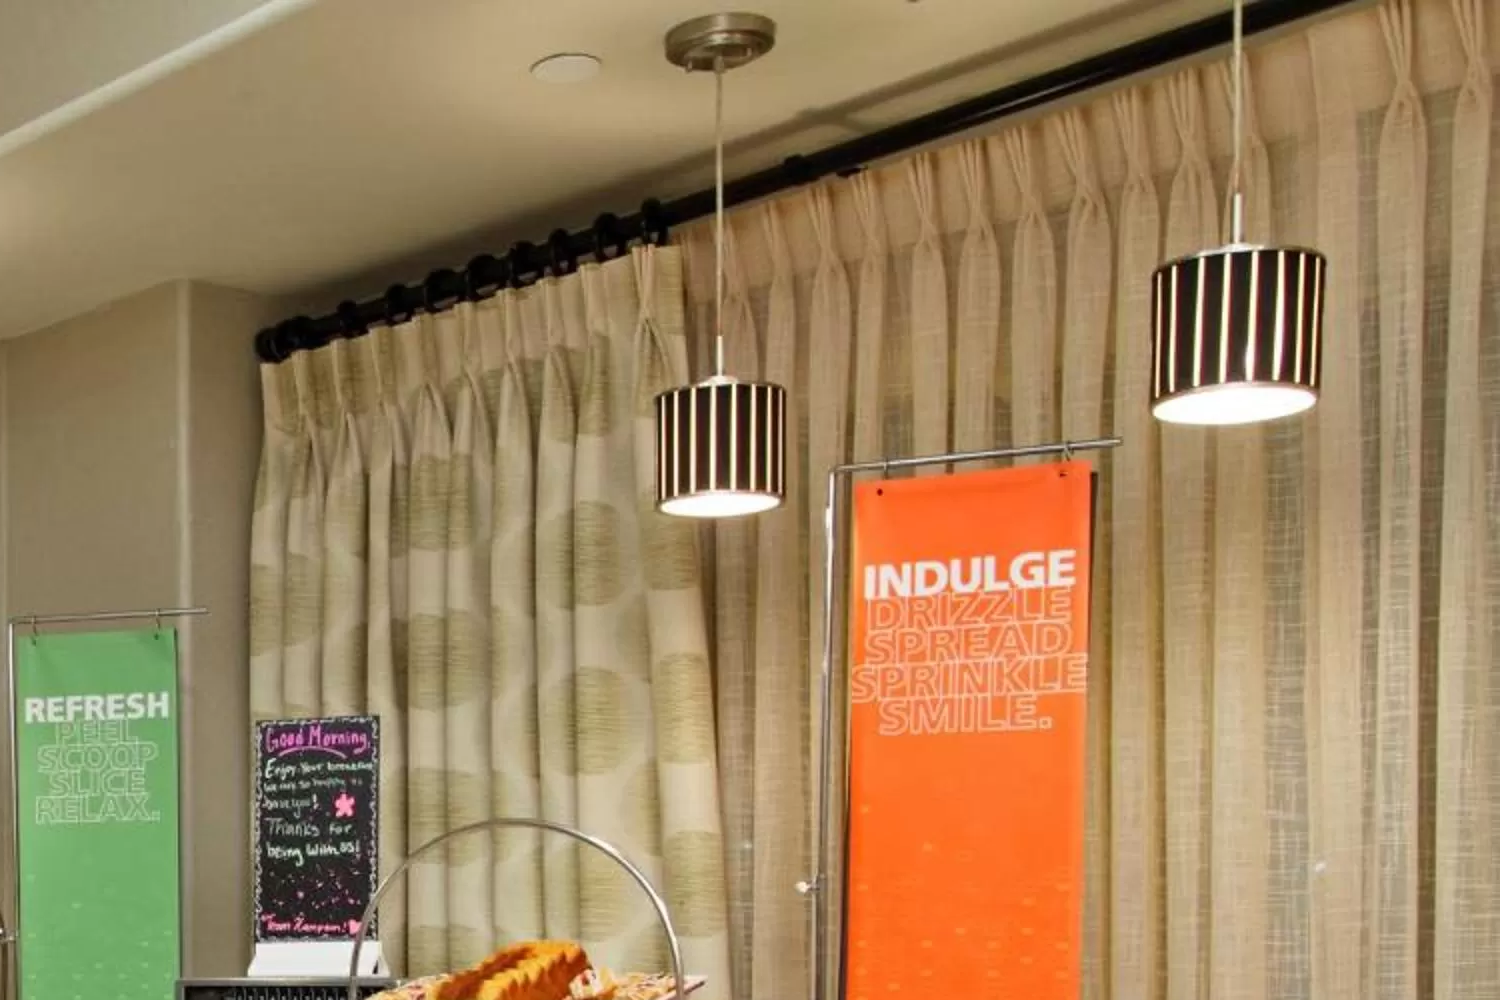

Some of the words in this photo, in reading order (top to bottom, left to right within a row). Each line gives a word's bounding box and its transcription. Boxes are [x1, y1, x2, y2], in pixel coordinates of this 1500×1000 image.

[864, 549, 1077, 600] INDULGE
[867, 583, 1073, 636] DRIZZLE
[866, 620, 1075, 668] SPREAD
[851, 652, 1088, 703] SPRINKLE
[24, 691, 170, 724] REFRESH
[878, 694, 1052, 736] SMILE.
[55, 719, 139, 747] PEEL
[266, 727, 304, 753] Good
[36, 741, 159, 774] SCOOP
[50, 767, 146, 800] SLICE
[35, 792, 161, 825] RELAX.
[264, 817, 320, 837] Thanks
[266, 842, 304, 867] being
